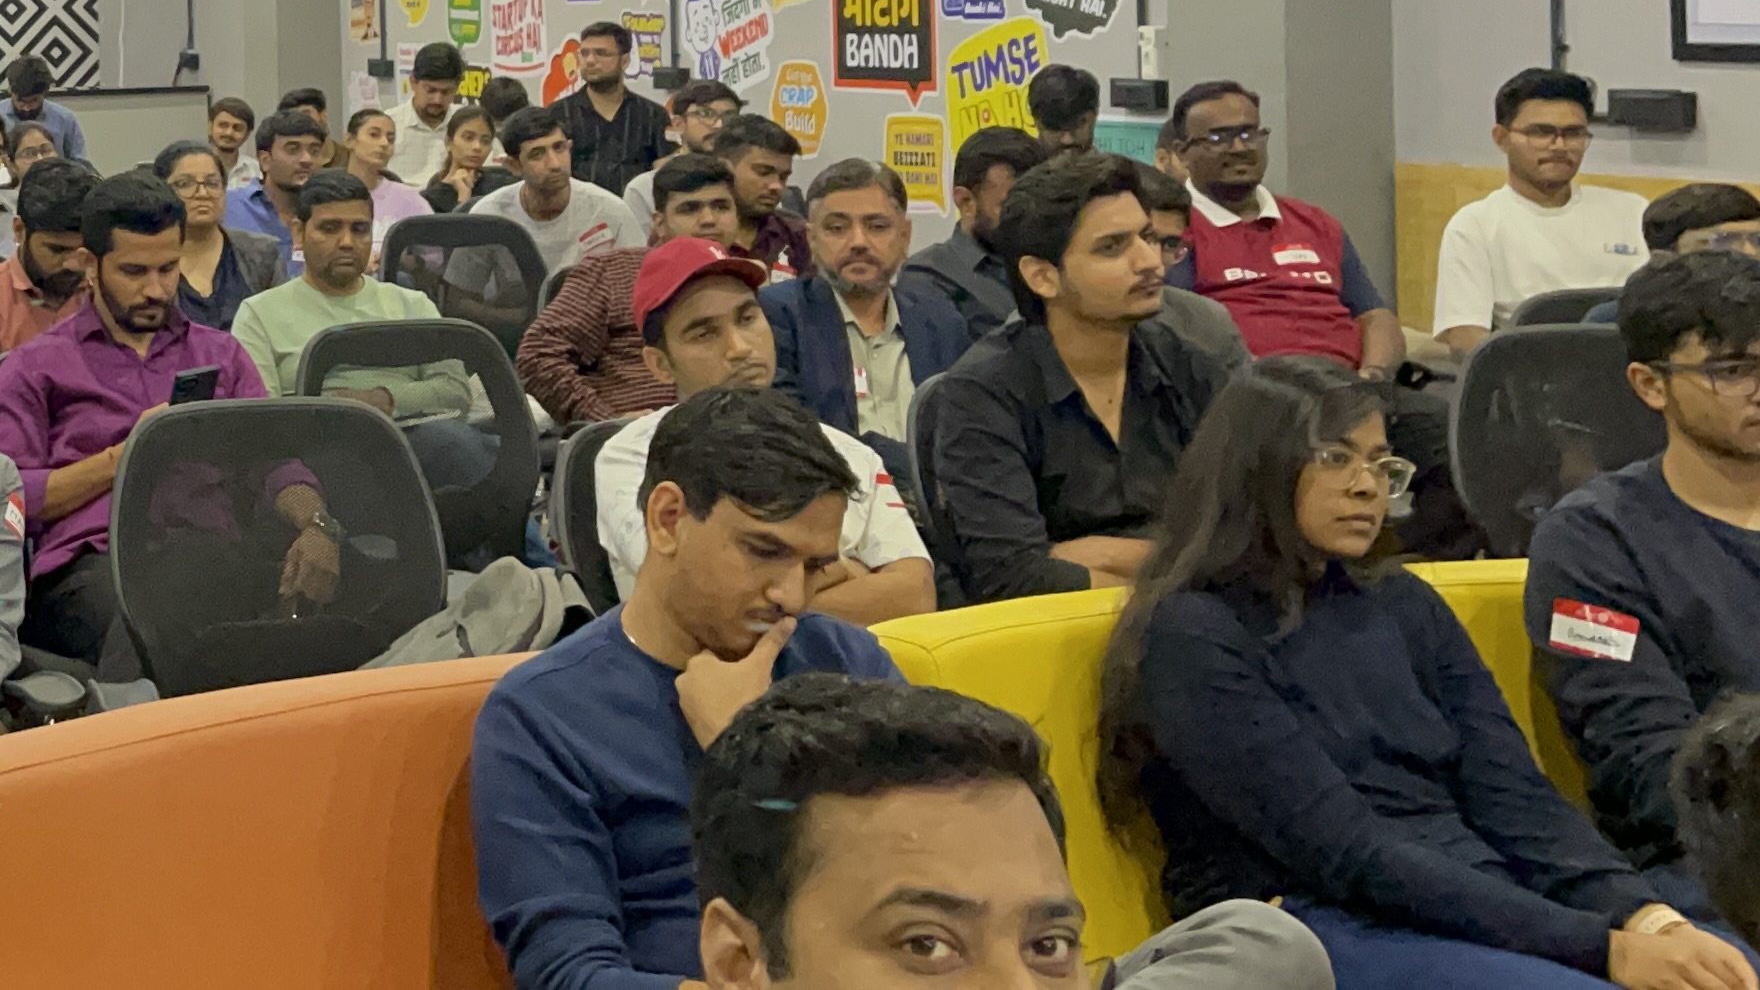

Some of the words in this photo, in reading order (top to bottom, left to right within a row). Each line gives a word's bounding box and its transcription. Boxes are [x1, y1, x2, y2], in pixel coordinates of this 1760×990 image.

[718, 12, 769, 60] WEEKEND
[846, 32, 919, 69] BANDH
[951, 32, 1041, 99] TUMSE
[780, 86, 817, 105] CRAP
[785, 110, 816, 134] Build
[895, 133, 904, 146] YE
